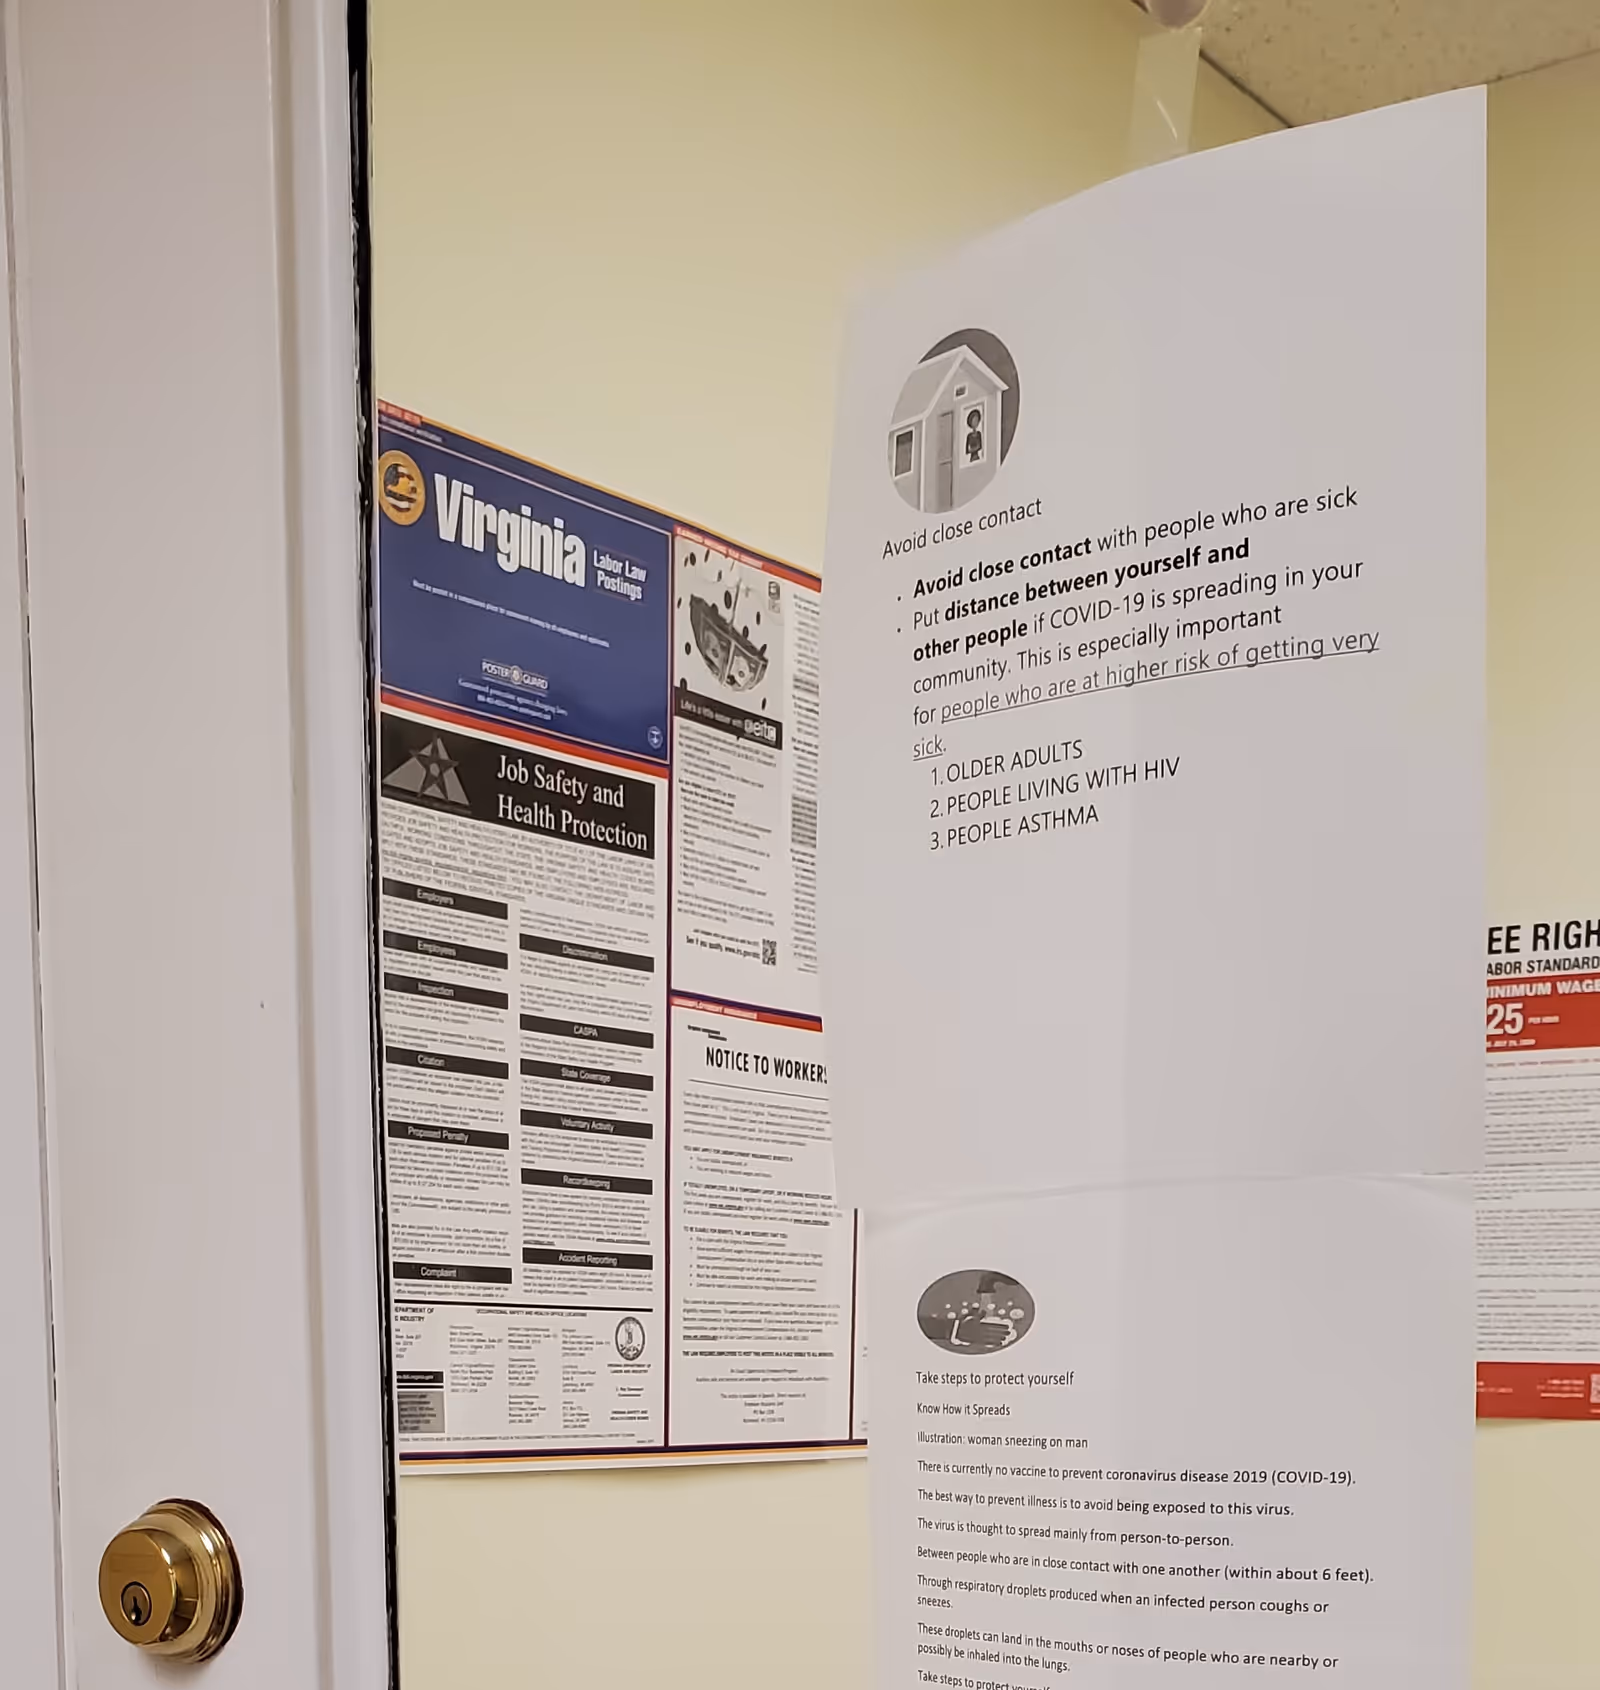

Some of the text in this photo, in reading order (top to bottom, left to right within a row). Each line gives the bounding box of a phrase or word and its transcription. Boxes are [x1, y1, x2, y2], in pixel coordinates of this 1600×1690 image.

[434, 473, 586, 587] Virginia
[882, 498, 1042, 560] Avoid close contact
[913, 485, 1358, 599] Avoid close contact with people who are sick
[594, 550, 647, 582] Labor Law
[597, 570, 642, 600] Postings
[914, 536, 1249, 631] Put distance between yourself and
[913, 562, 1364, 662] other people if COVID-19 is spreading in your
[913, 605, 1282, 694] community. This is especially important
[912, 632, 1380, 726] for people who are at higher risk of getting very
[912, 734, 946, 762] sick.
[946, 754, 1005, 782] OLDER
[1010, 739, 1083, 772] ADULTS
[497, 755, 624, 808] Job Safety and
[947, 785, 1012, 816] PEOPLE
[1018, 773, 1079, 802] LIVING
[1085, 763, 1136, 790] WITH
[1145, 756, 1180, 781] HIV
[498, 794, 555, 830] Health
[561, 809, 647, 850] Protection
[948, 818, 1012, 848] PEOPLE
[1017, 804, 1099, 836] ASTHMA
[1487, 982, 1552, 998] INIMUM
[706, 1046, 749, 1072] NOTICE
[753, 1055, 769, 1075] TO
[915, 1370, 1074, 1388] Take steps to protect yourself
[917, 1402, 1010, 1418] Know How it Spreads
[917, 1431, 1088, 1450] Illustration: woman sneezing on man
[917, 1460, 1356, 1487] There is currently no vaccine to prevent coronavirus disease 2019 (COVID-19).
[917, 1517, 1234, 1548] The virus is thought to spread mainly from person-to-person.
